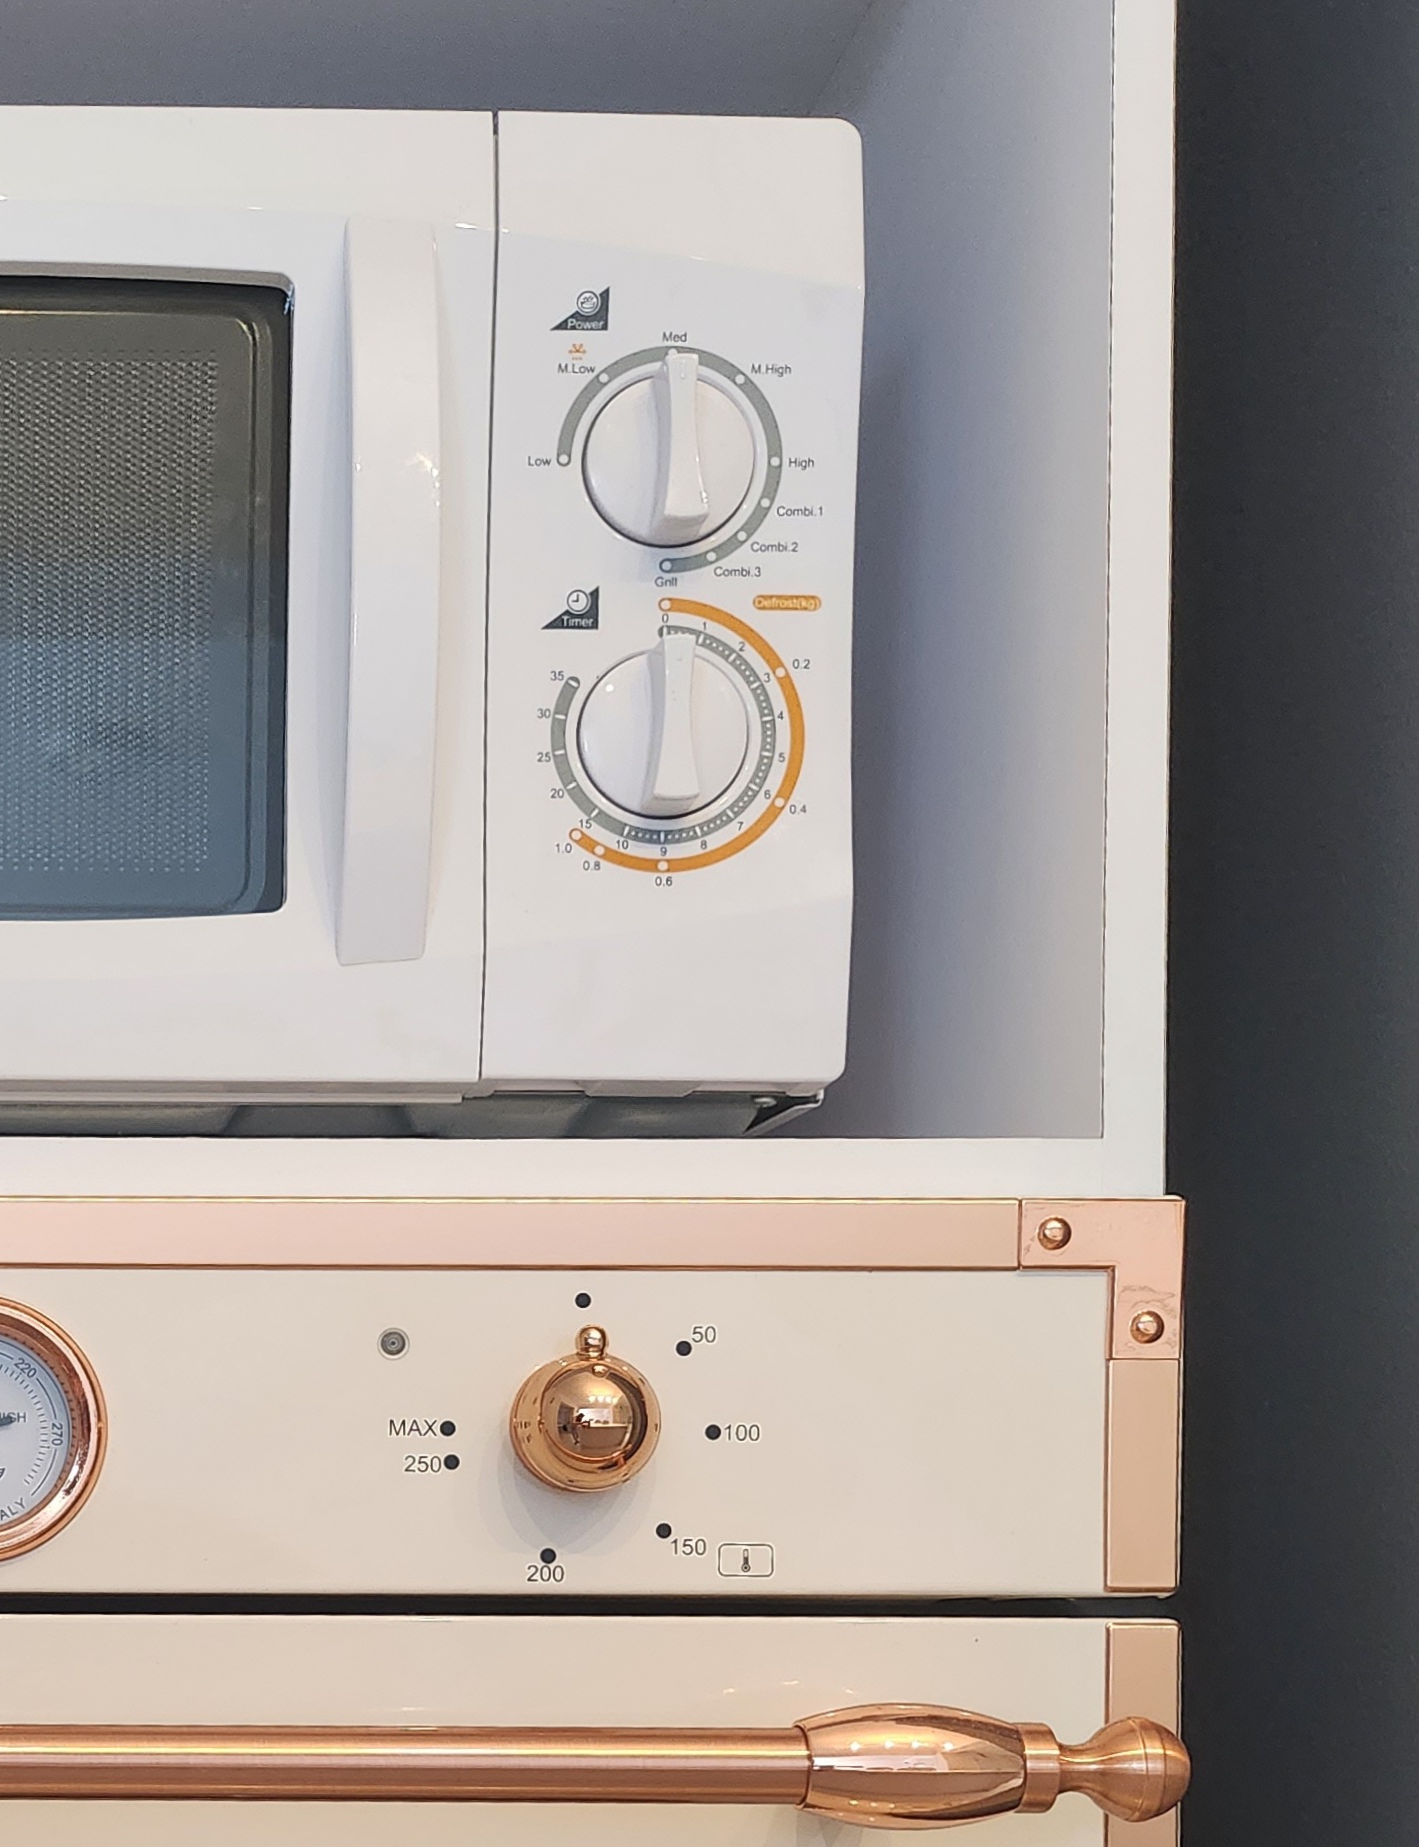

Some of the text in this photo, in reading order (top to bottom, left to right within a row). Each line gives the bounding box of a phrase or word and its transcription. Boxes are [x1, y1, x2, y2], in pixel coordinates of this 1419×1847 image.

[567, 318, 605, 330] Power
[662, 332, 688, 343] Med
[557, 363, 596, 374] M.Low
[750, 364, 792, 376] M.High
[527, 456, 552, 467] Low
[788, 458, 815, 470] High
[776, 506, 823, 517] Combi.1
[750, 541, 799, 552] Combi.2
[713, 566, 761, 577] Combi.3
[561, 616, 594, 628] Timer
[662, 613, 669, 624] 0
[738, 641, 746, 652] 2
[792, 659, 811, 670] 0.2
[550, 671, 564, 682] 35
[763, 672, 771, 683] 3
[537, 709, 551, 720] 30
[777, 711, 785, 720] 4
[537, 752, 551, 763] 25
[778, 752, 786, 763] 5
[550, 789, 565, 799] 20
[763, 789, 771, 800] 6
[789, 804, 807, 815] 0.4
[579, 819, 592, 830] 15
[737, 822, 744, 831] 7
[555, 844, 572, 854] 1.0
[616, 840, 628, 850] 10
[700, 839, 707, 850] 8
[660, 845, 667, 857] 9
[582, 861, 601, 871] 0.8
[654, 876, 673, 887] 0.6
[691, 1326, 717, 1344] 50
[13, 1357, 37, 1379] 220
[389, 1419, 438, 1437] MAX
[724, 1424, 761, 1441] 100
[52, 1422, 64, 1447] 270
[404, 1455, 442, 1473] 250
[670, 1538, 707, 1556] 150
[526, 1565, 564, 1583] 200
